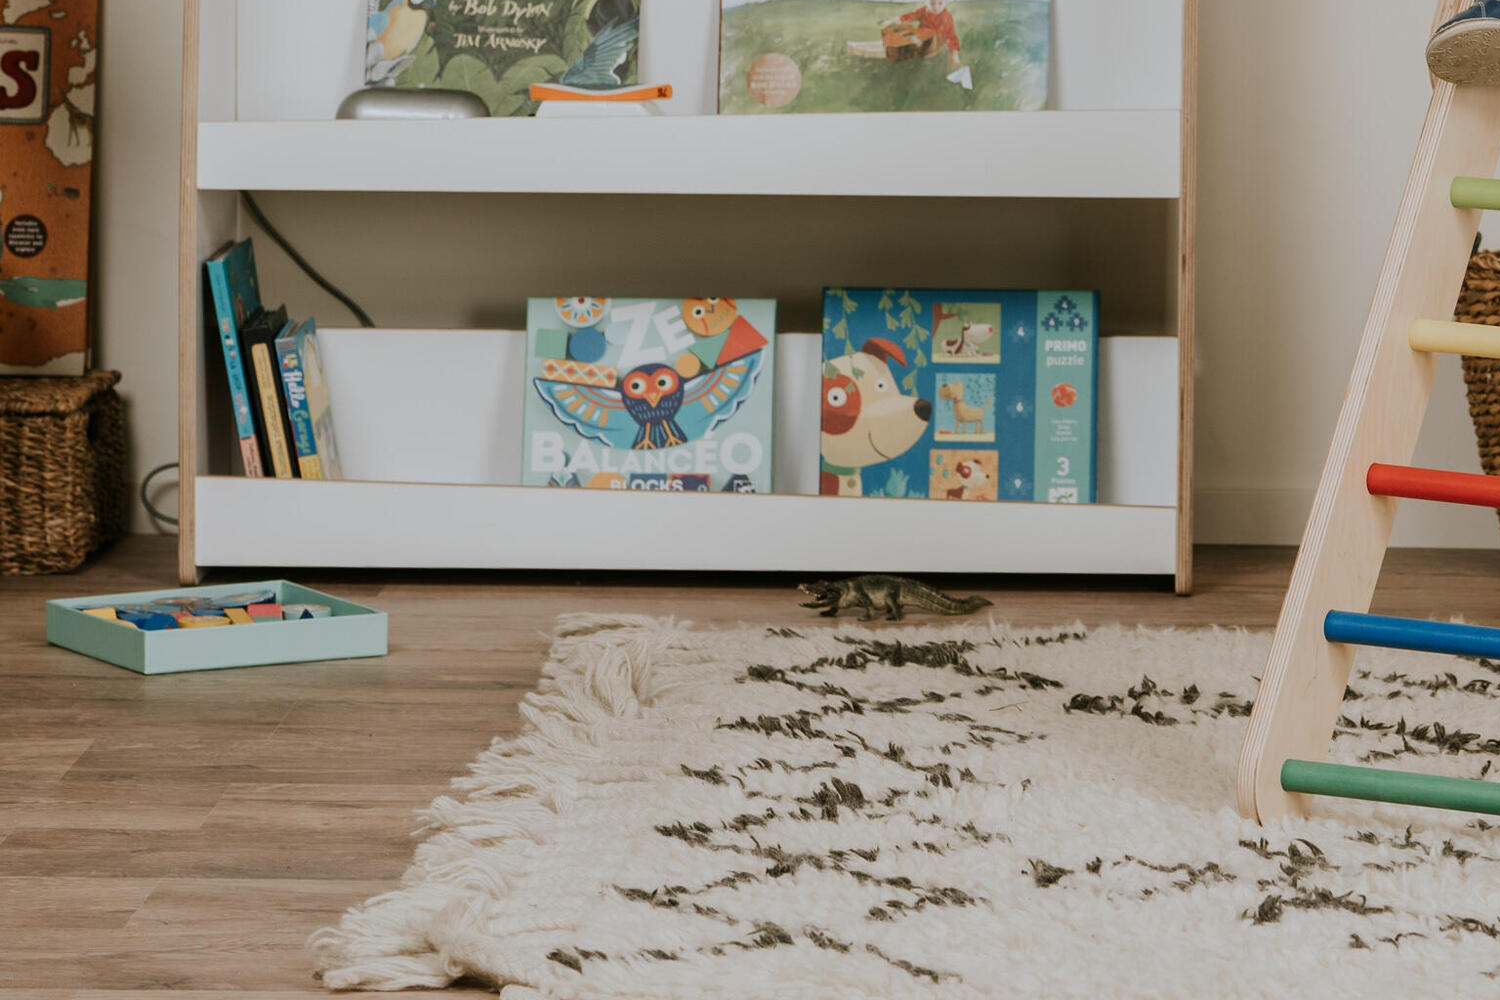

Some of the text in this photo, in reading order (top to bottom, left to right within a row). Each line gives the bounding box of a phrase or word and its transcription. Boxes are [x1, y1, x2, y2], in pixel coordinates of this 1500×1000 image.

[1044, 340, 1087, 352] PRIMO
[1046, 354, 1085, 368] puzzle
[530, 431, 763, 475] BALANCEO
[1056, 456, 1070, 476] 3
[610, 479, 684, 492] BLOCKS
